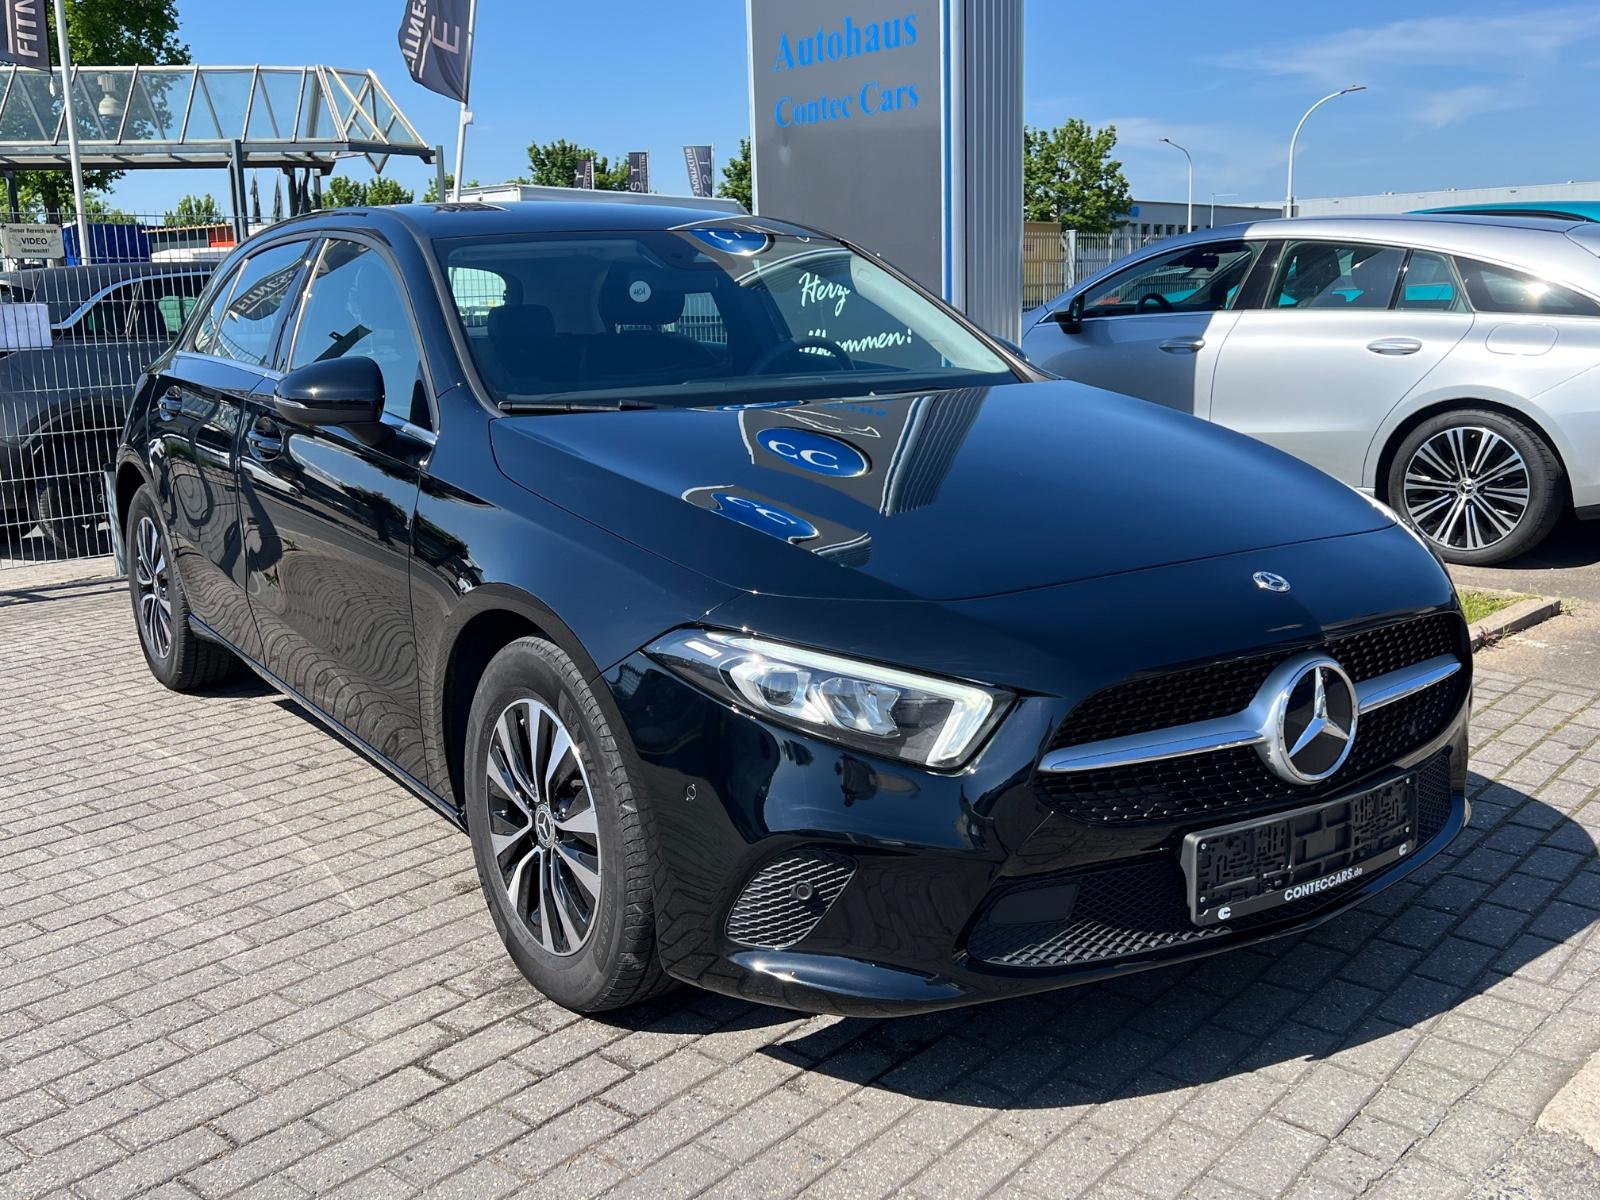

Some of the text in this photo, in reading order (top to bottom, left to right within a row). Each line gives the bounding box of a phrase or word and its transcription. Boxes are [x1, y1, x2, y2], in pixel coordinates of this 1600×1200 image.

[772, 15, 917, 73] Autohaus
[774, 80, 919, 128] Contec Cars
[21, 237, 47, 245] VIDEO
[1284, 867, 1363, 901] CONTECCARS.de
